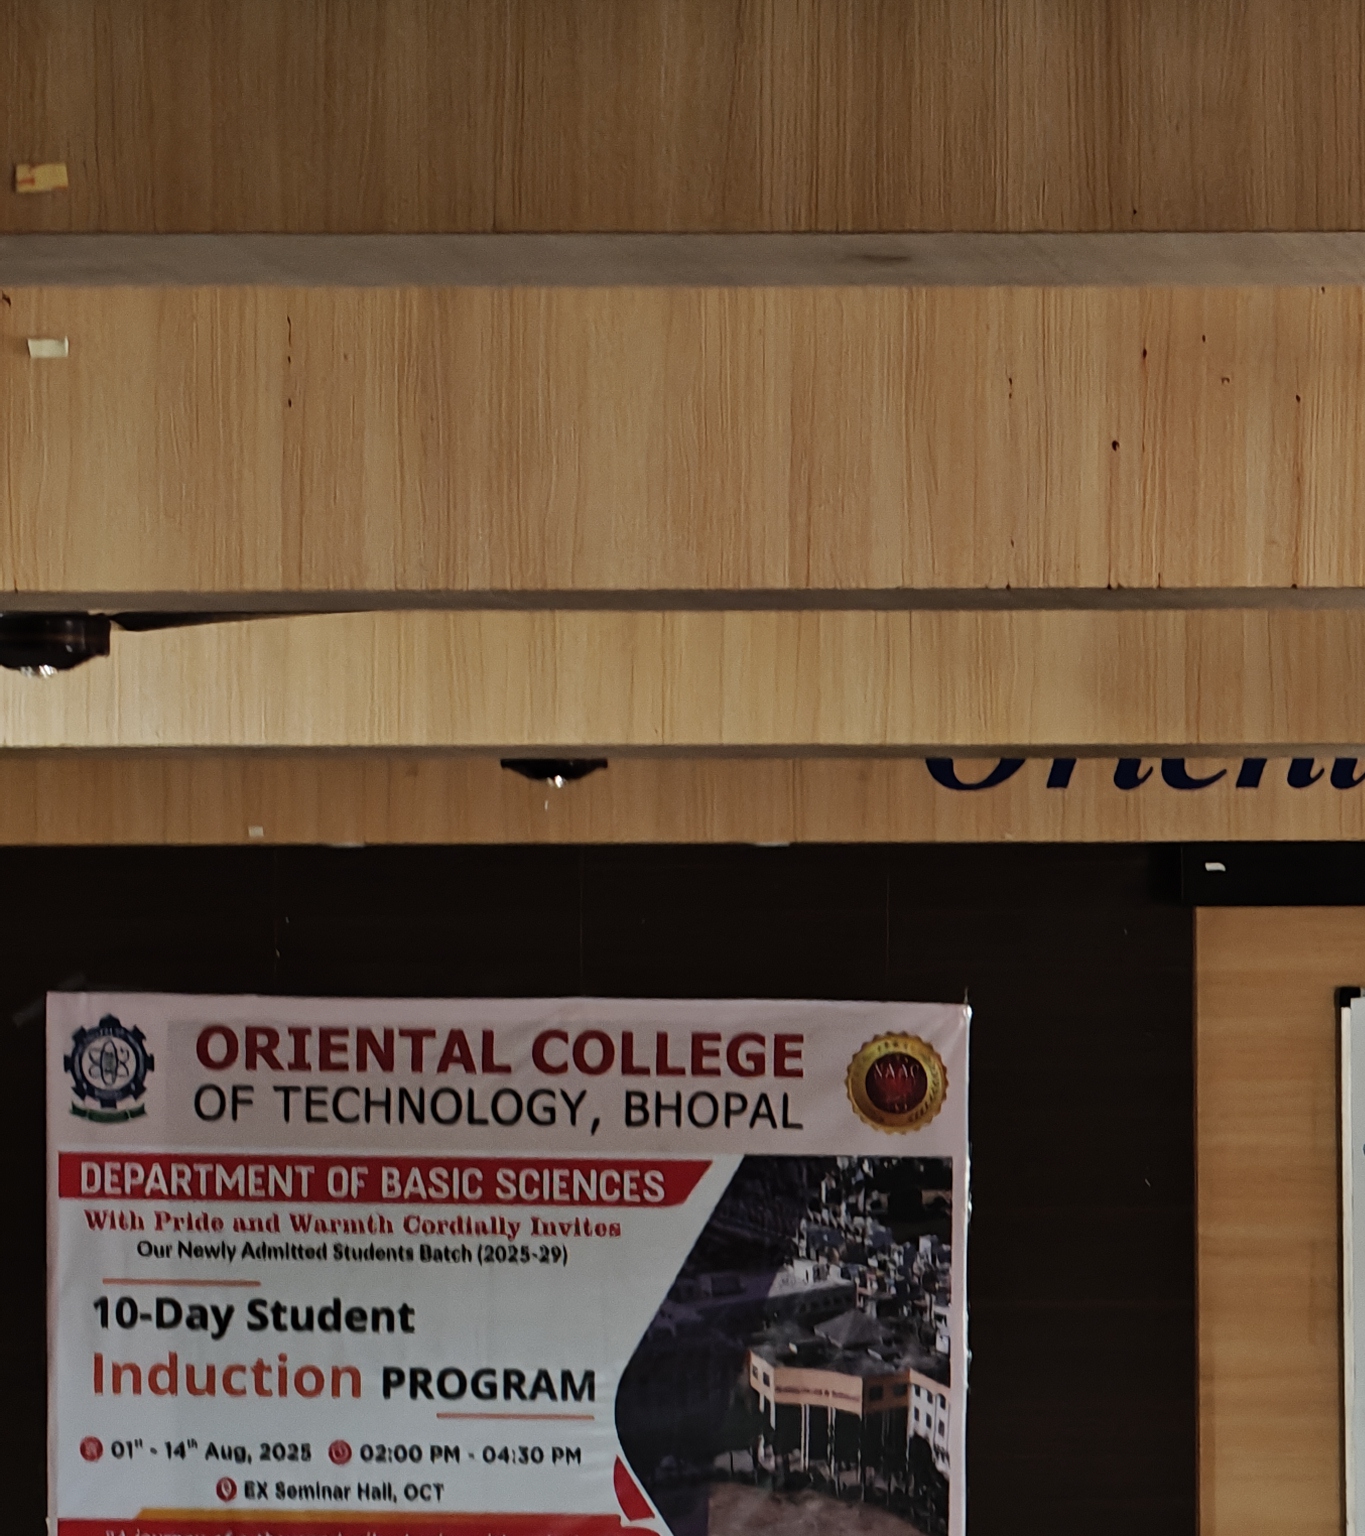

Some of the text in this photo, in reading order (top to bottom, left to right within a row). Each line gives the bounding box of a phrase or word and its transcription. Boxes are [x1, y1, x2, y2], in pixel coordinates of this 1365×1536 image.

[196, 1025, 804, 1078] ORIENTAL COLLEGE
[194, 1084, 803, 1135] OF TECHNOLOGY, BHOPAL
[80, 1161, 666, 1201] DEPARTMENT OF BASIC SCIENCES
[84, 1209, 621, 1241] With Pride and Warmth Cordially Invites
[137, 1240, 568, 1266] Our Newly Admitted Students Batch (2025-29)
[93, 1296, 415, 1340] 10-Day Student
[93, 1351, 595, 1402] Induction PROGRAM
[205, 1441, 252, 1464] Aug,
[259, 1442, 312, 1462] 2025
[360, 1443, 422, 1464] 02:00
[430, 1444, 460, 1464] PM
[482, 1445, 544, 1465] 04:30
[552, 1446, 582, 1466] PM
[244, 1480, 444, 1504] EX Seminar Hall, OCT
